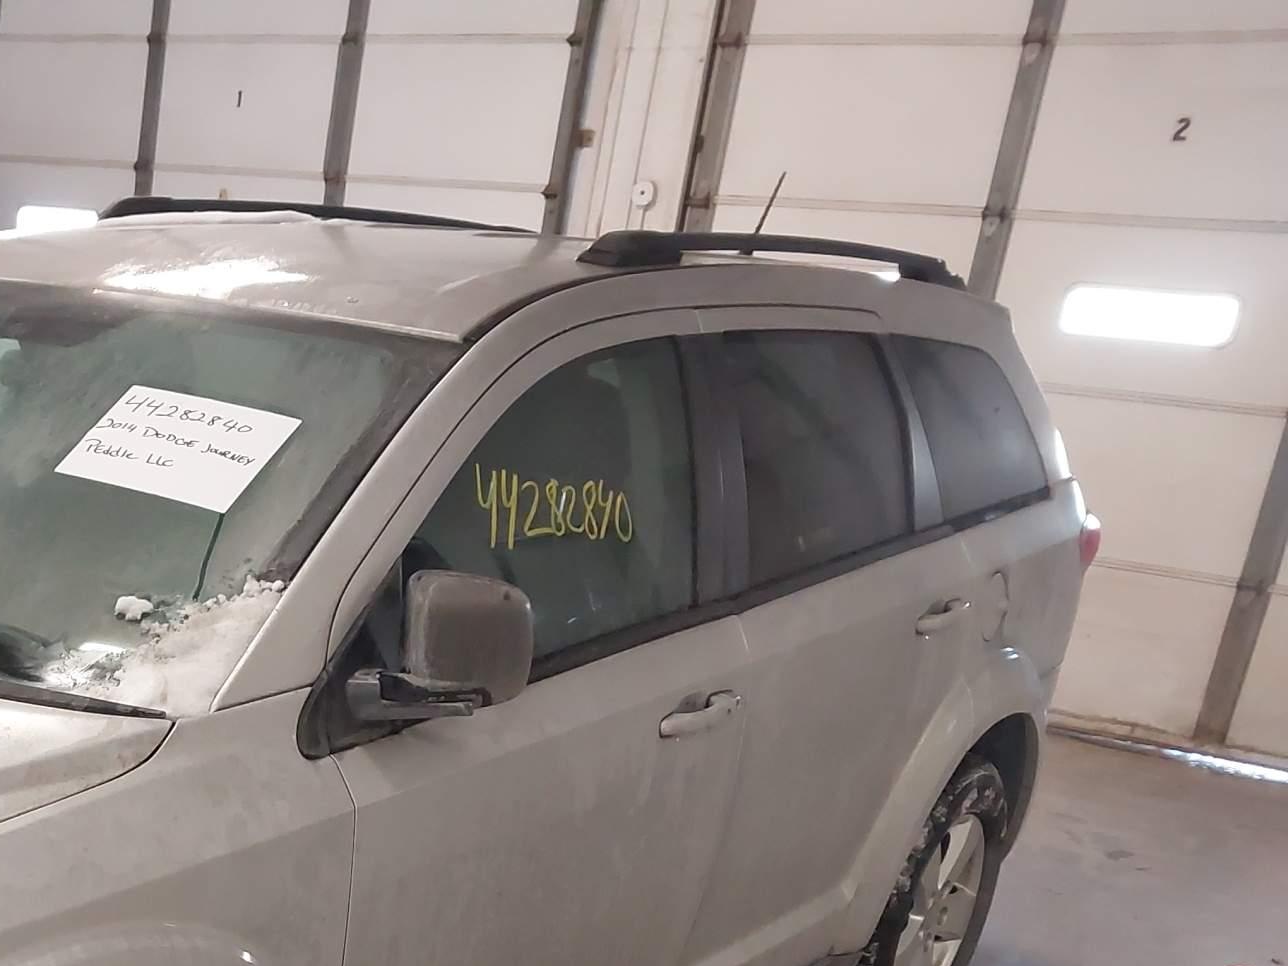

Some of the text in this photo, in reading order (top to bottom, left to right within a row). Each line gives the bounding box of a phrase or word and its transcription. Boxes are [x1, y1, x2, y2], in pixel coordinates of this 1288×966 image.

[1172, 117, 1192, 142] 2
[95, 418, 137, 433] 2014
[124, 394, 254, 434] 44282840
[474, 463, 633, 551] 44282840
